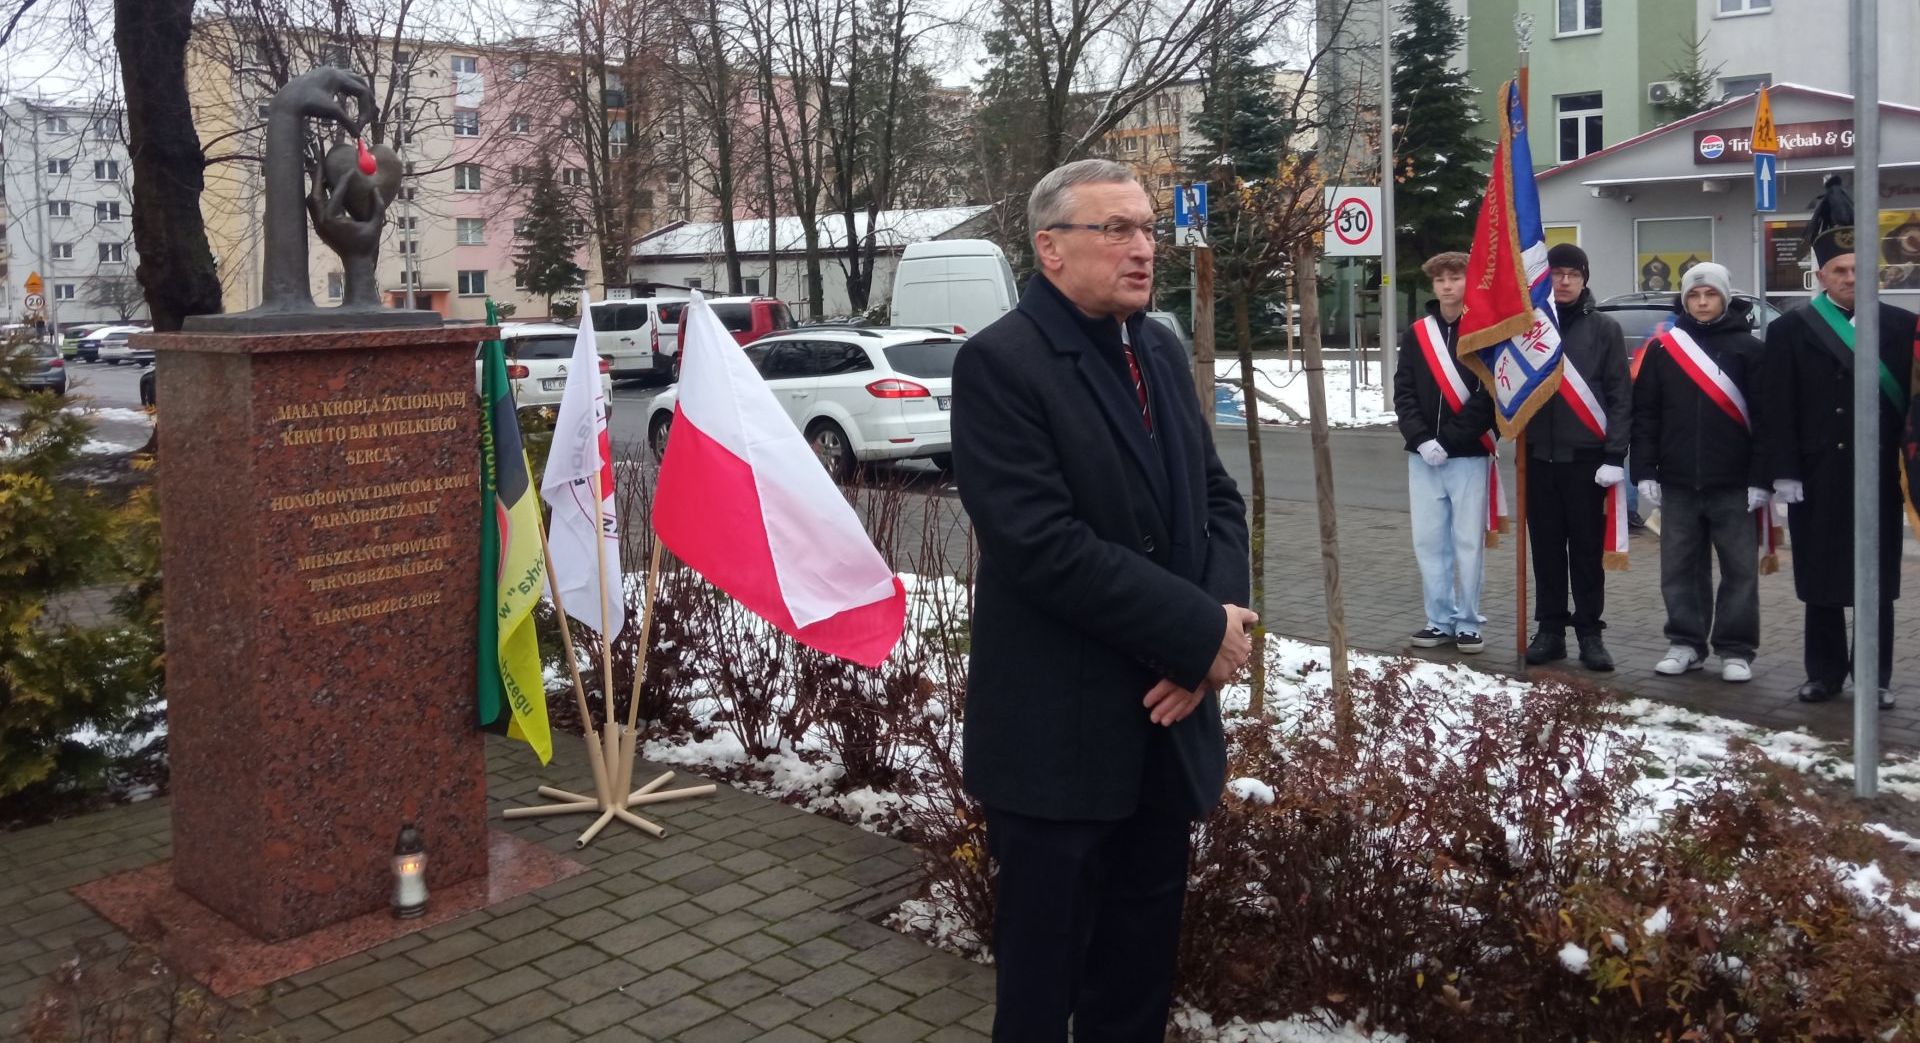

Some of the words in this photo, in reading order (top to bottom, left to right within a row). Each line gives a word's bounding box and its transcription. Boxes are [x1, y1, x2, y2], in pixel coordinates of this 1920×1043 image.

[1776, 132, 1822, 150] Kebab
[1824, 131, 1838, 145] &
[1182, 187, 1200, 214] P
[1340, 210, 1367, 232] 30
[29, 298, 42, 306] 20
[323, 399, 380, 416] KROPLA
[382, 391, 466, 412] ŻYCIODAJNEJ
[282, 429, 323, 446] KRWI
[327, 427, 346, 442] TO
[350, 424, 378, 440] DAR
[381, 416, 457, 437] WIELKIEGO
[271, 487, 369, 511] HONOROWYM
[373, 479, 431, 498] DAWCOM
[434, 474, 471, 490] KRWI
[311, 500, 439, 529] TARNOBRZEŻANIE
[374, 526, 381, 539] I
[297, 543, 388, 571] MIESZKAŃCY
[391, 536, 451, 556] POWIATU
[307, 558, 444, 592] TARNOBRZESKIEGO
[312, 596, 408, 625] TARNOBRZEG
[409, 591, 441, 606] 2022
